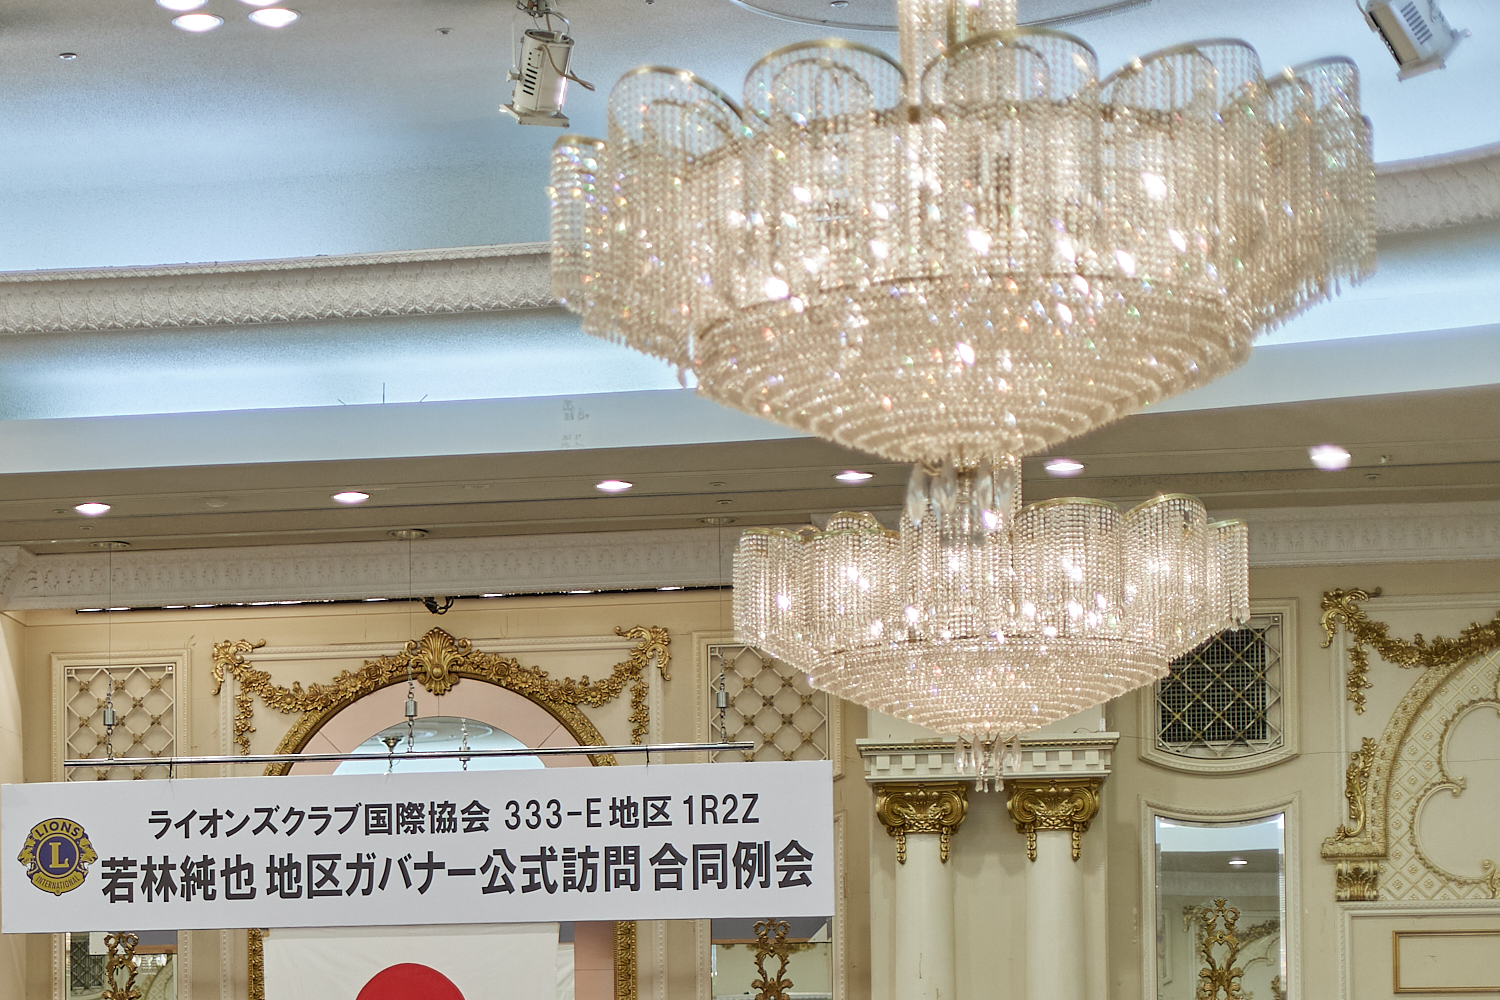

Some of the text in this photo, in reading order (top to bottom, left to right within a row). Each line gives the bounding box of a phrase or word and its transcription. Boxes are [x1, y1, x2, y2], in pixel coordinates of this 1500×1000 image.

[148, 799, 491, 840] ライオンズクラブ国際協会
[683, 793, 760, 825] 1R2Z
[35, 821, 81, 838] LIONS
[49, 842, 70, 868] L
[35, 875, 81, 890] INTERNATIONAL
